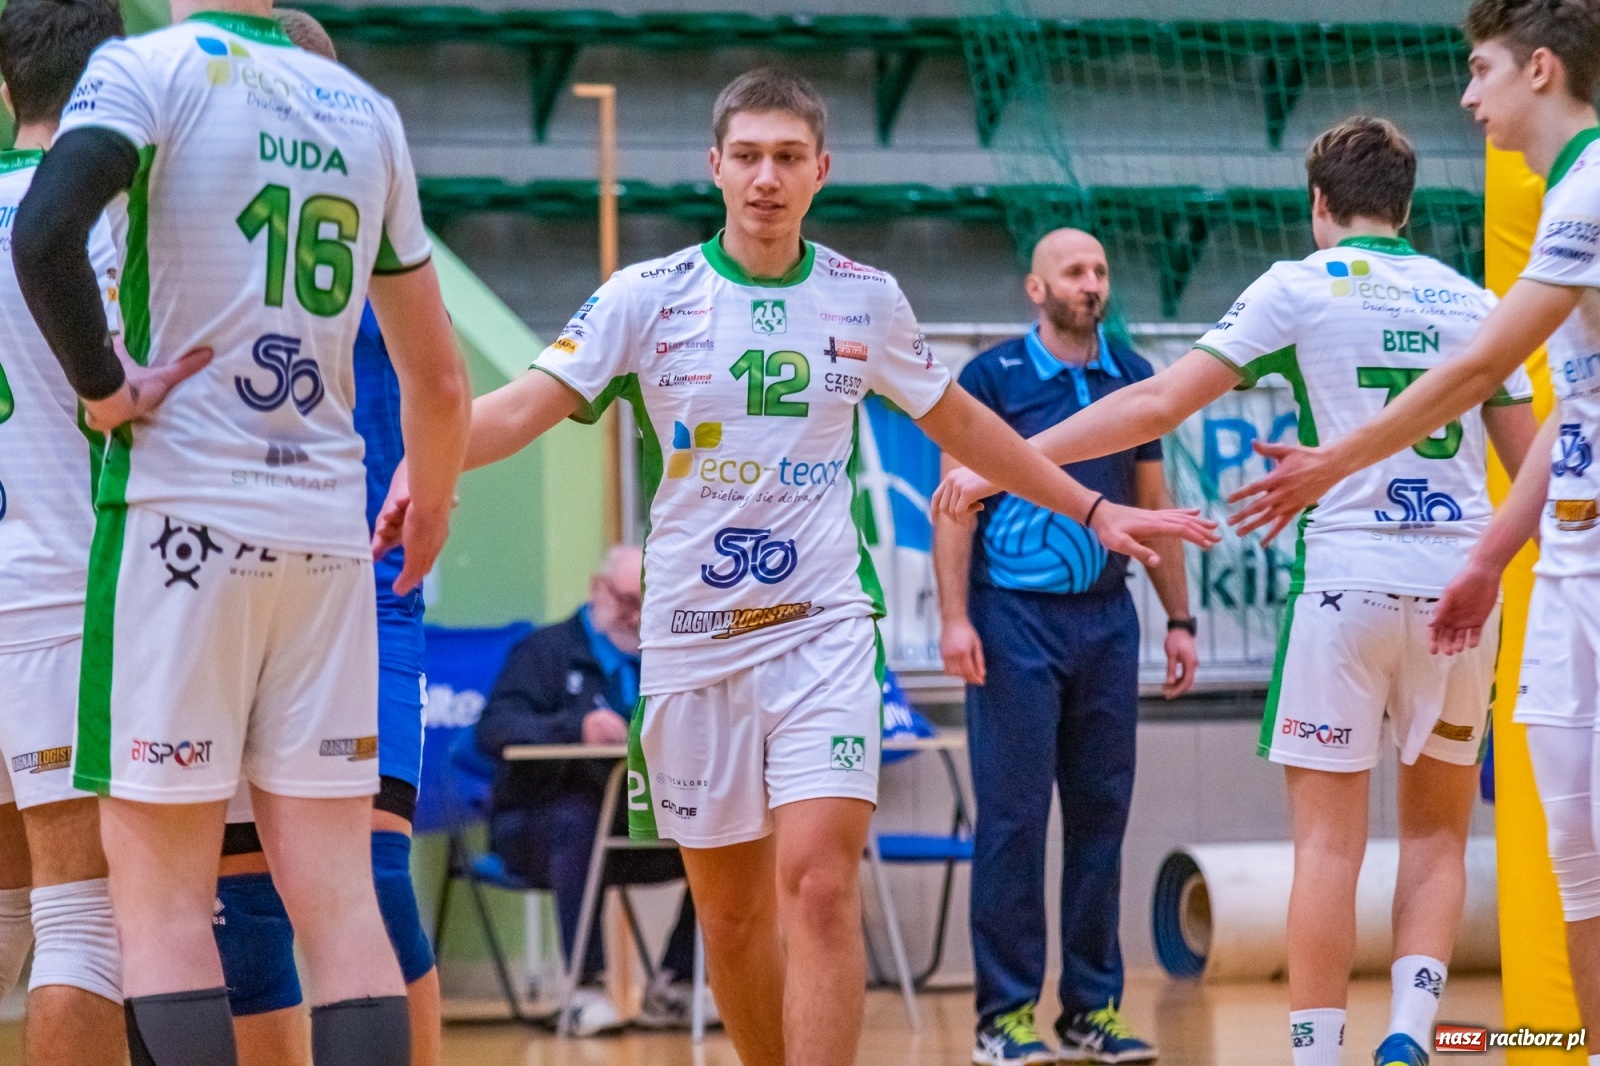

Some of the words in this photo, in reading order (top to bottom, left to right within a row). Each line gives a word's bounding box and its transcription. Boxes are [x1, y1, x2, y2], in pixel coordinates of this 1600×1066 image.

[259, 130, 349, 177] DUDA
[236, 182, 360, 317] 16
[1382, 324, 1440, 354] BIEŃ
[729, 348, 810, 418] 12
[231, 469, 338, 492] STILMAR
[1281, 717, 1353, 744] BTSPORT
[131, 738, 213, 768] BTSPORT
